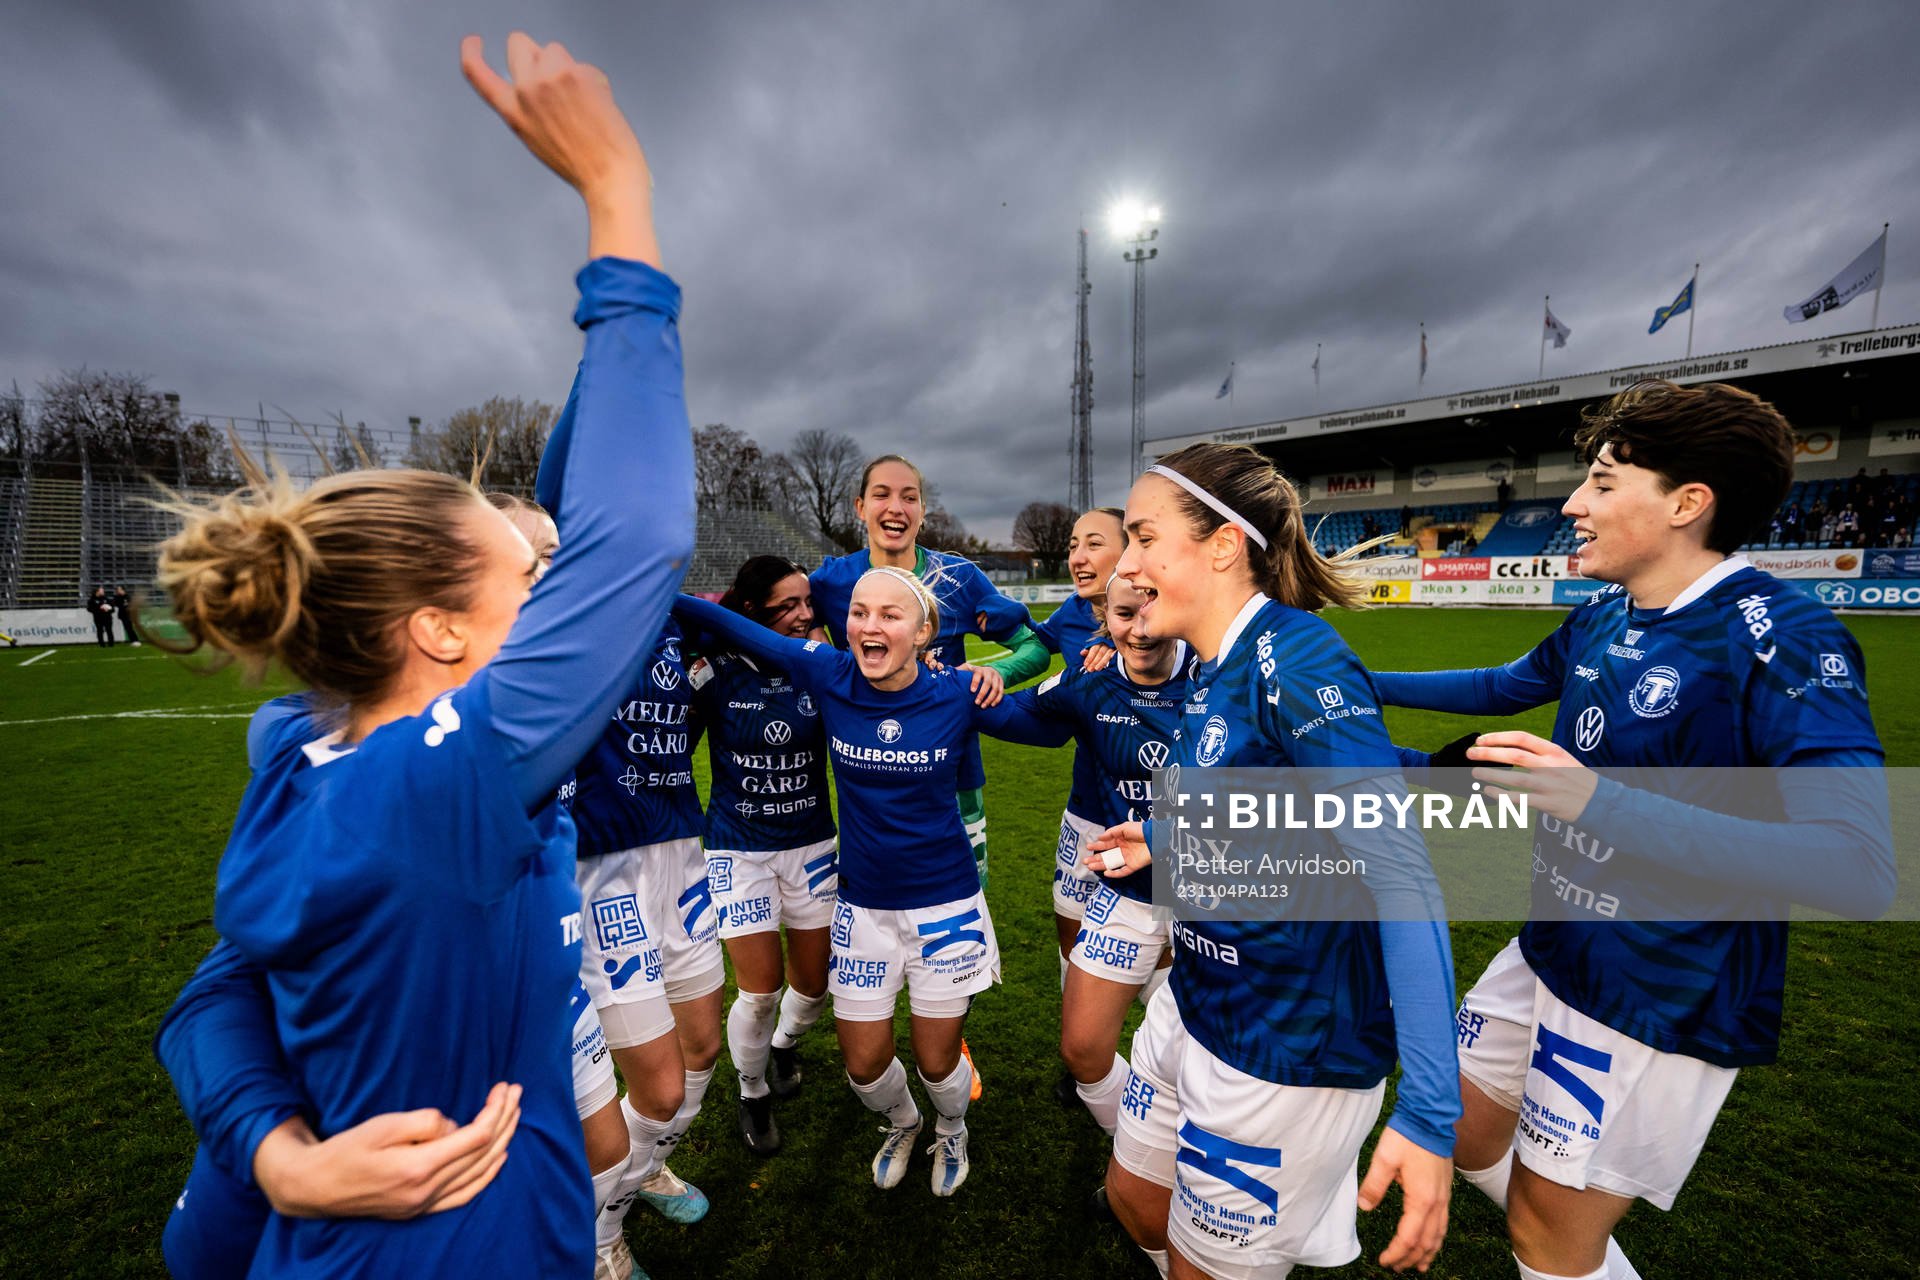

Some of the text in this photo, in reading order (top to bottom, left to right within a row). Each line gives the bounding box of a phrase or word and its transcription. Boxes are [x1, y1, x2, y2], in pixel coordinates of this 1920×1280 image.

[1460, 384, 1560, 408] Trelleborgs Allehanda
[1497, 558, 1559, 577] cc.it.
[1755, 558, 1831, 570] Swedbank
[1421, 583, 1453, 594] akea
[1488, 583, 1524, 594] akea
[728, 701, 757, 710] CRAFT
[1325, 709, 1350, 720] CLUB
[1096, 713, 1130, 725] CRAFT
[831, 736, 948, 764] TRELLEBORGS FF
[914, 765, 933, 773] 2024
[741, 773, 809, 794] GÅRD
[730, 896, 771, 915] INTER
[731, 909, 772, 928] SPORT
[1088, 931, 1139, 958] INTER
[840, 956, 886, 975] INTER
[1084, 945, 1137, 970] SPORT
[838, 970, 885, 988] SPORT
[952, 970, 976, 984] CRAFT
[1541, 1106, 1576, 1131] Hamn
[1581, 1123, 1600, 1140] AB
[1520, 1118, 1553, 1149] CRAFT
[1219, 1206, 1255, 1225] Hamn
[1260, 1215, 1277, 1227] AB
[1191, 1217, 1238, 1242] CRAFT
